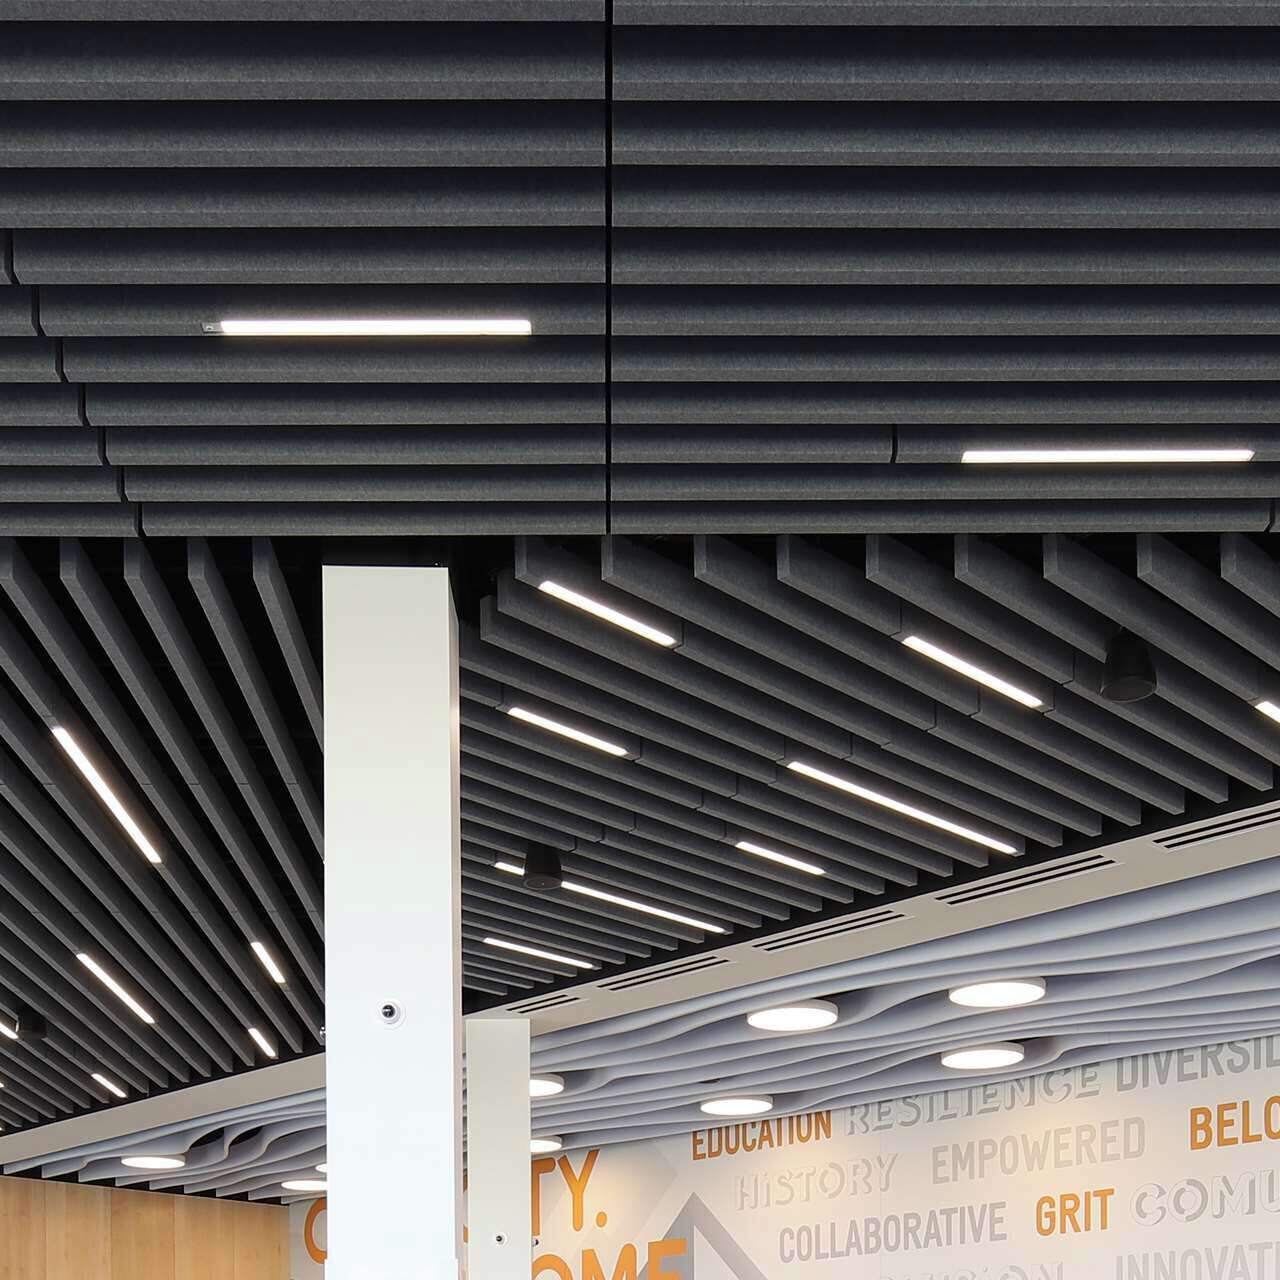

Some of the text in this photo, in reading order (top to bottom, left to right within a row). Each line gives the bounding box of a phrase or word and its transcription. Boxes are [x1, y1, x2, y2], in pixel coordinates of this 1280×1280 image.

[692, 1109, 832, 1160] EDUCATION
[932, 1116, 1146, 1185] EMPOWERED
[779, 1201, 1007, 1263] COLLABORATIVE
[1035, 1187, 1115, 1237] GRIT
